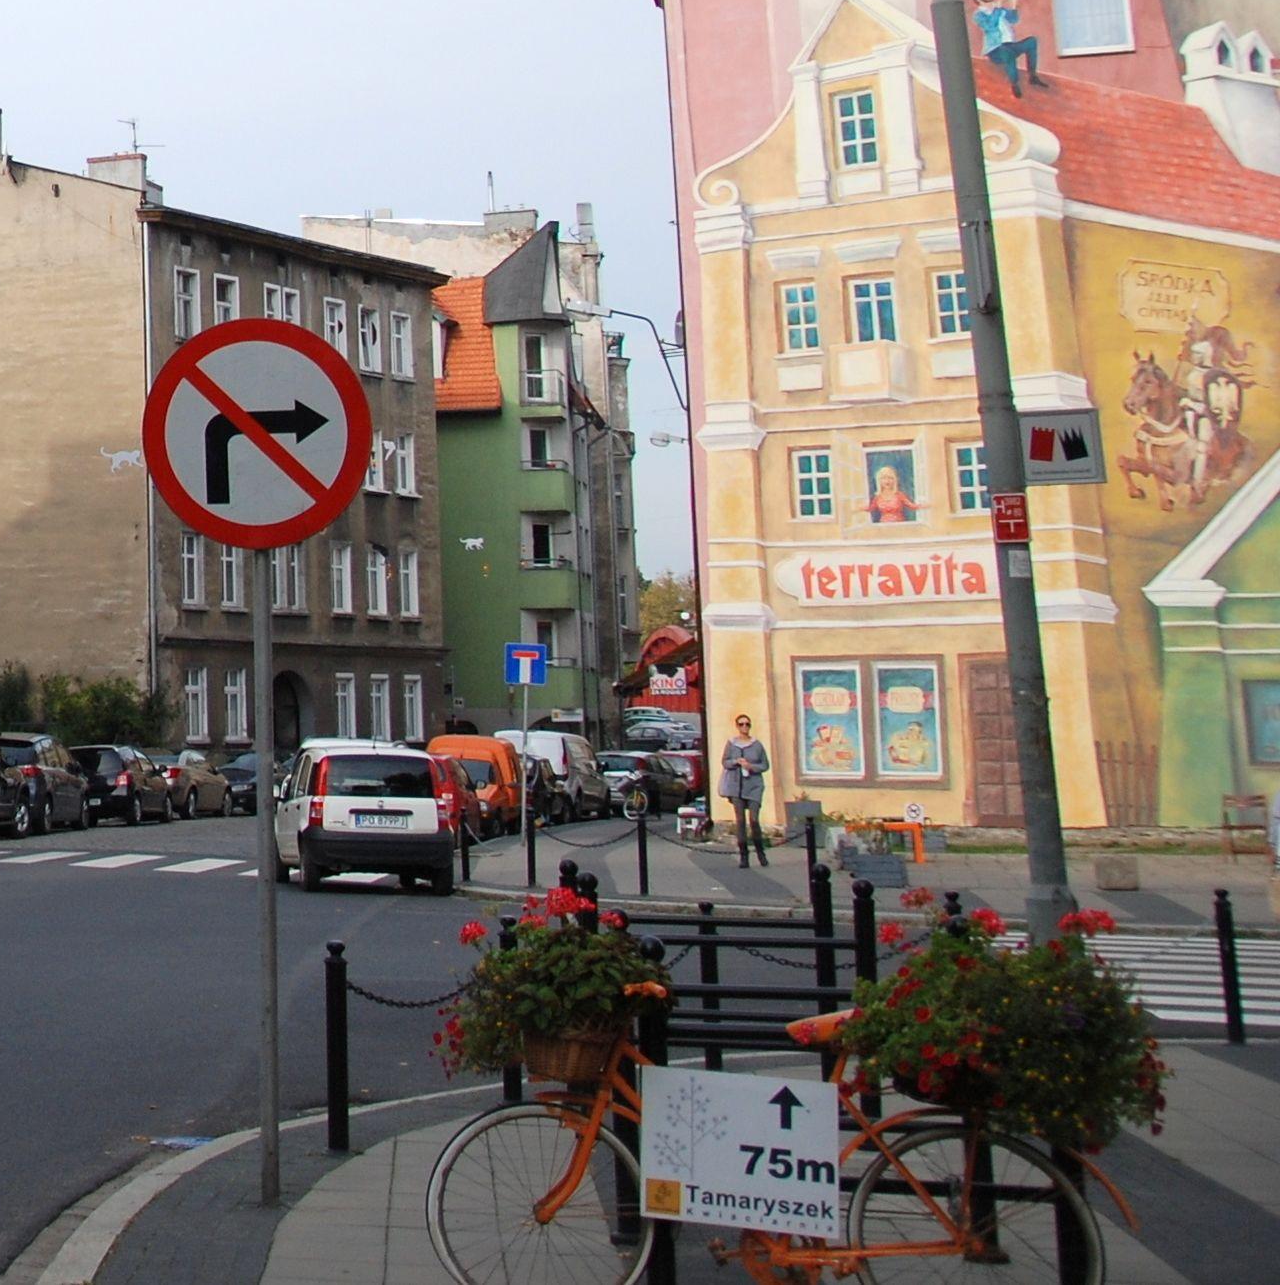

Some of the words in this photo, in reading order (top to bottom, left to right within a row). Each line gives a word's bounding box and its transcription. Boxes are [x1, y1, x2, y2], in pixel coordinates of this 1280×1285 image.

[801, 552, 987, 599] terravita
[652, 678, 686, 689] KINO
[739, 1143, 836, 1185] 75m
[685, 1184, 835, 1221] Tamaryszek
